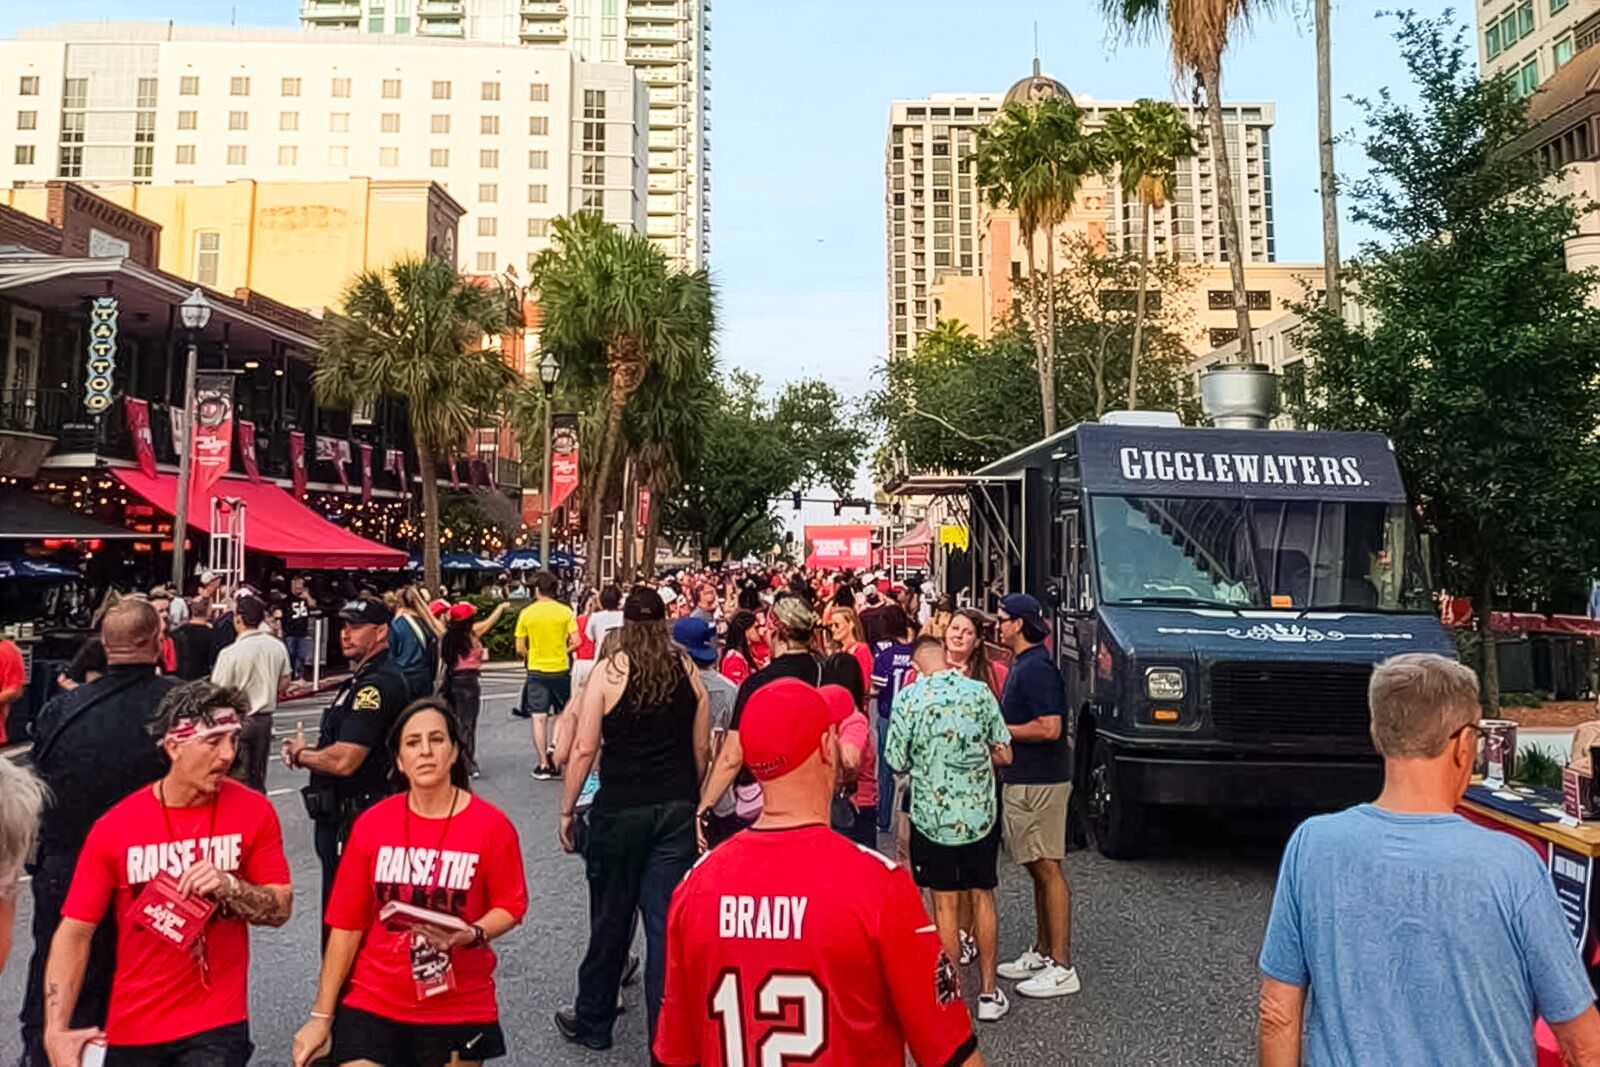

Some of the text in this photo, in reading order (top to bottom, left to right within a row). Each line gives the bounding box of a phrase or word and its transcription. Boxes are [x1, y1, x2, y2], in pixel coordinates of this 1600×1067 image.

[88, 308, 116, 410] TATTOO
[1120, 447, 1370, 486] GIGGLEWATERS.
[126, 832, 243, 885] RAISE THE
[375, 845, 480, 891] RAISE THE
[719, 895, 808, 939] BRADY
[710, 969, 827, 1067] 12
